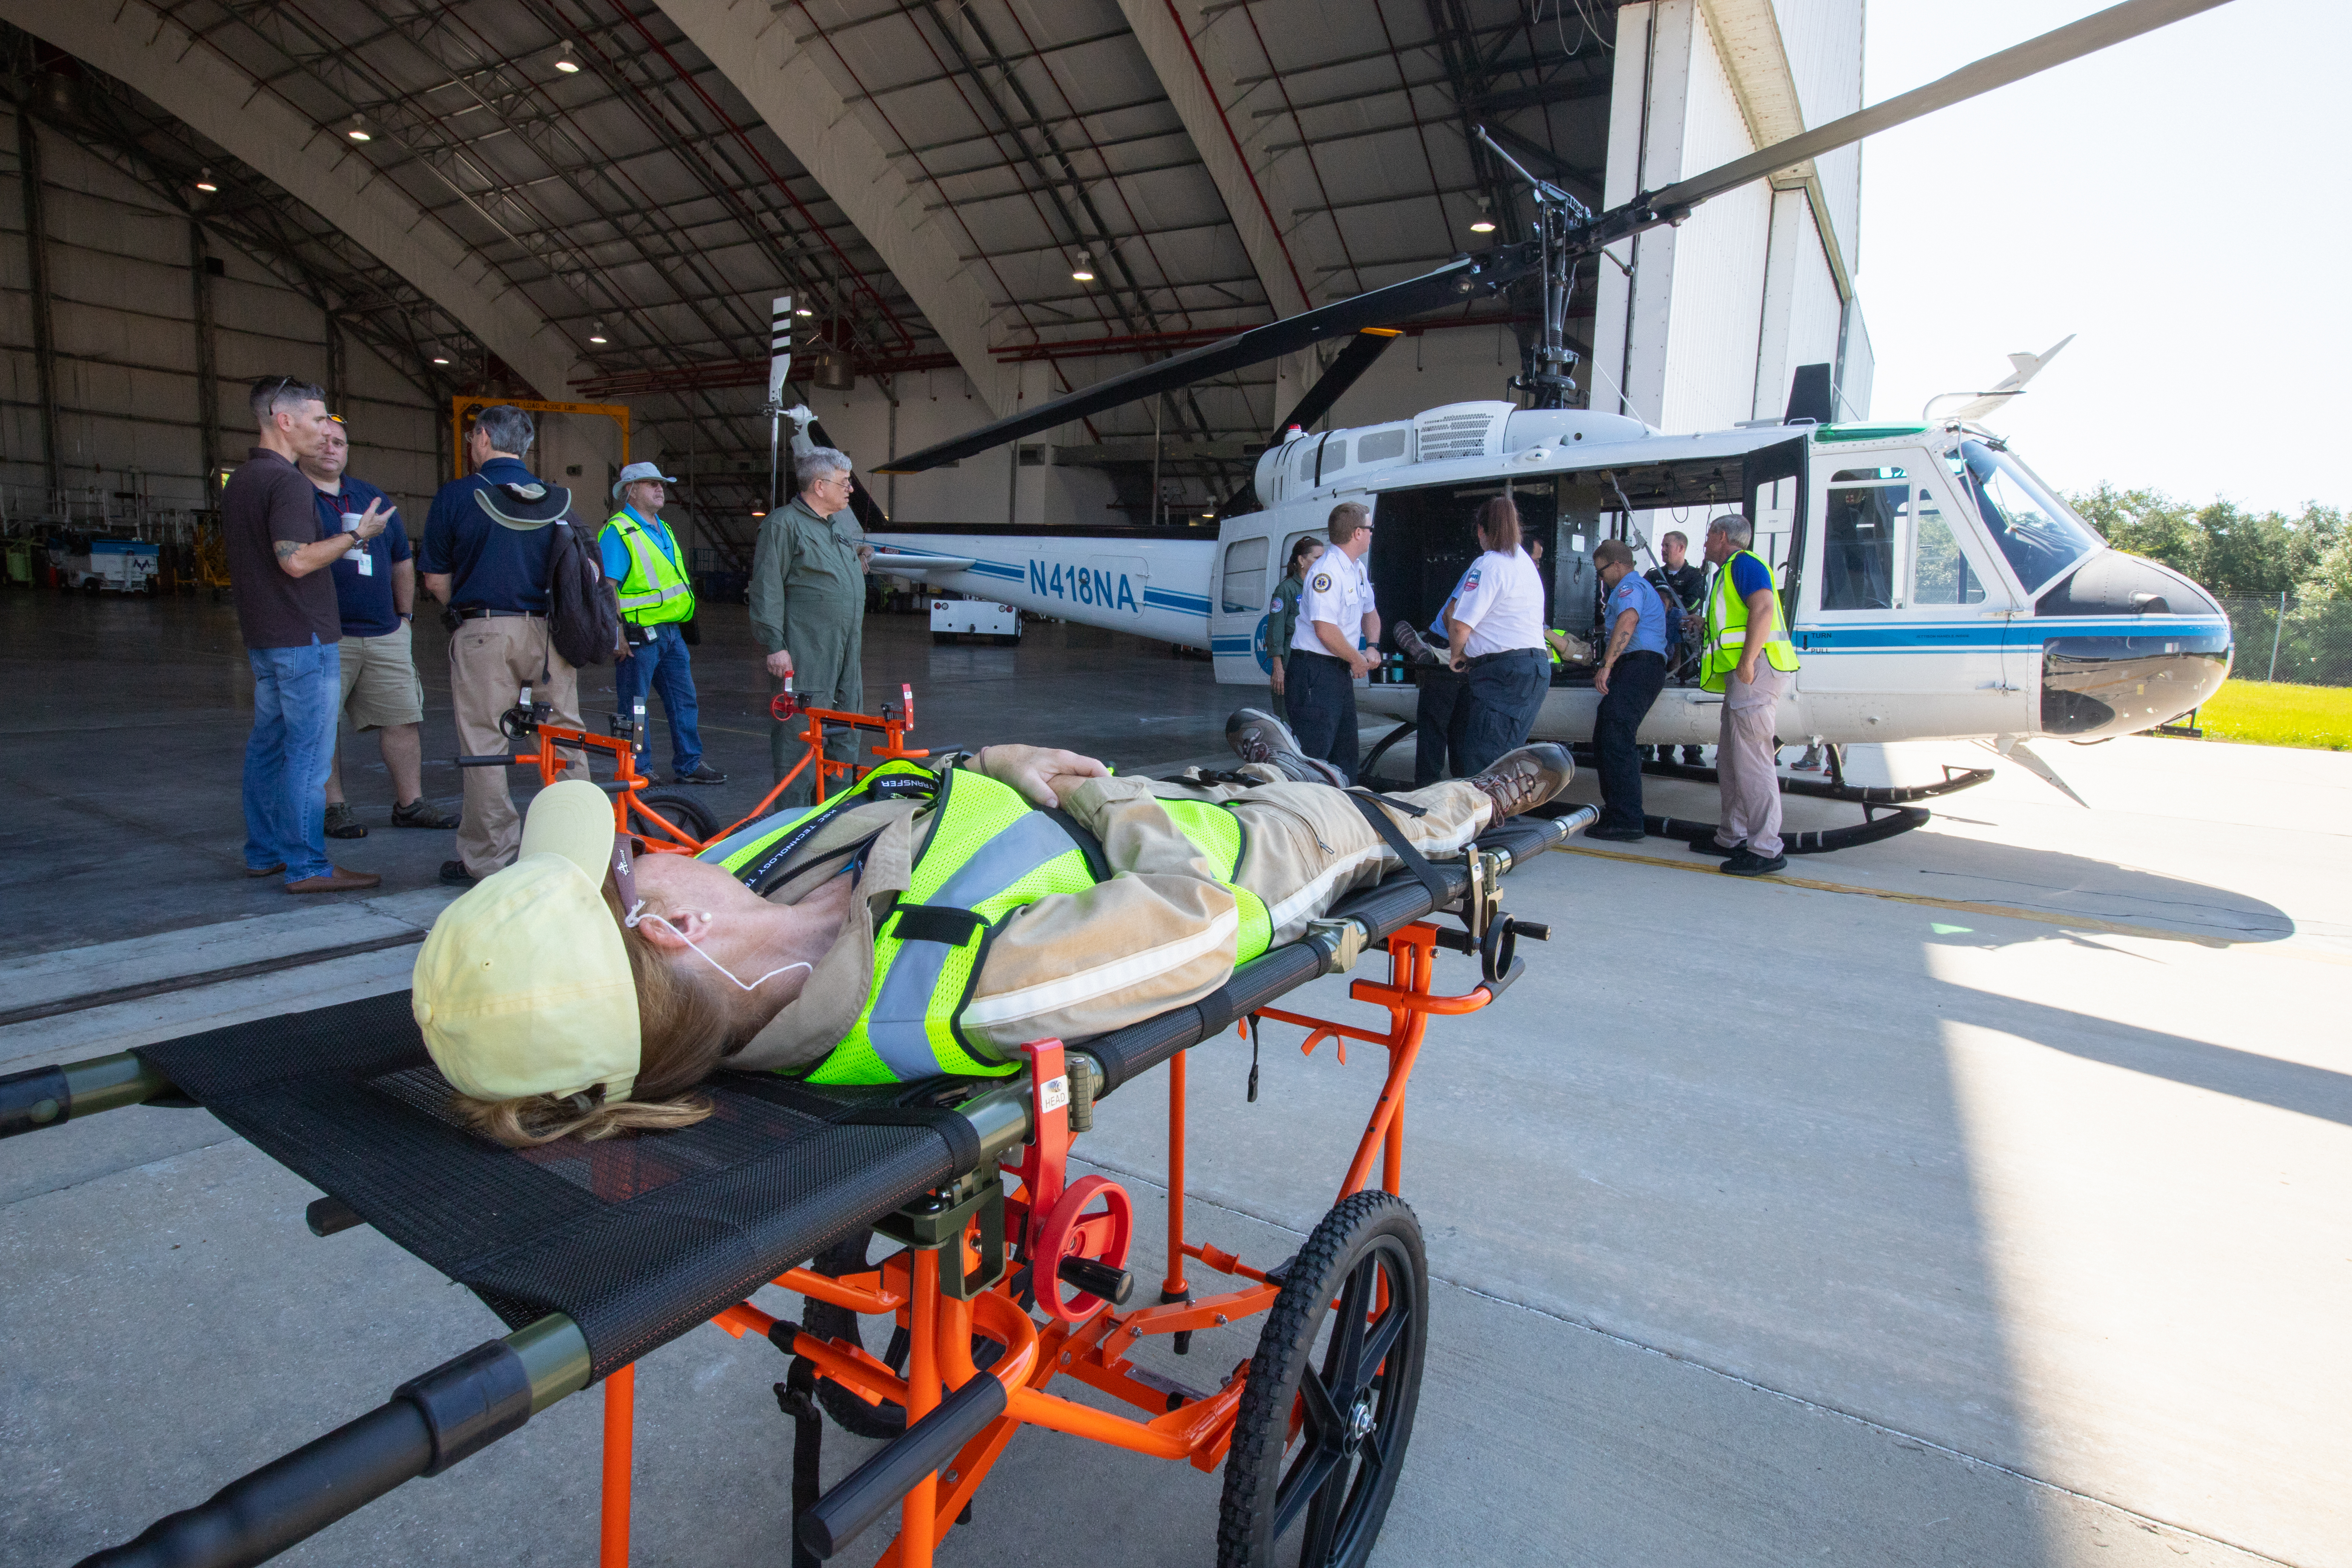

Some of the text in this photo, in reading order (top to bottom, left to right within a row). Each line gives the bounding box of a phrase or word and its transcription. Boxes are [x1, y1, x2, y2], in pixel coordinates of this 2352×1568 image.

[1030, 559, 1138, 613] N418NA
[881, 779, 935, 790] TRANSFER
[817, 809, 837, 823] KSC
[758, 825, 816, 875] TECHNOLOGY
[1045, 1092, 1065, 1109] HEAD
